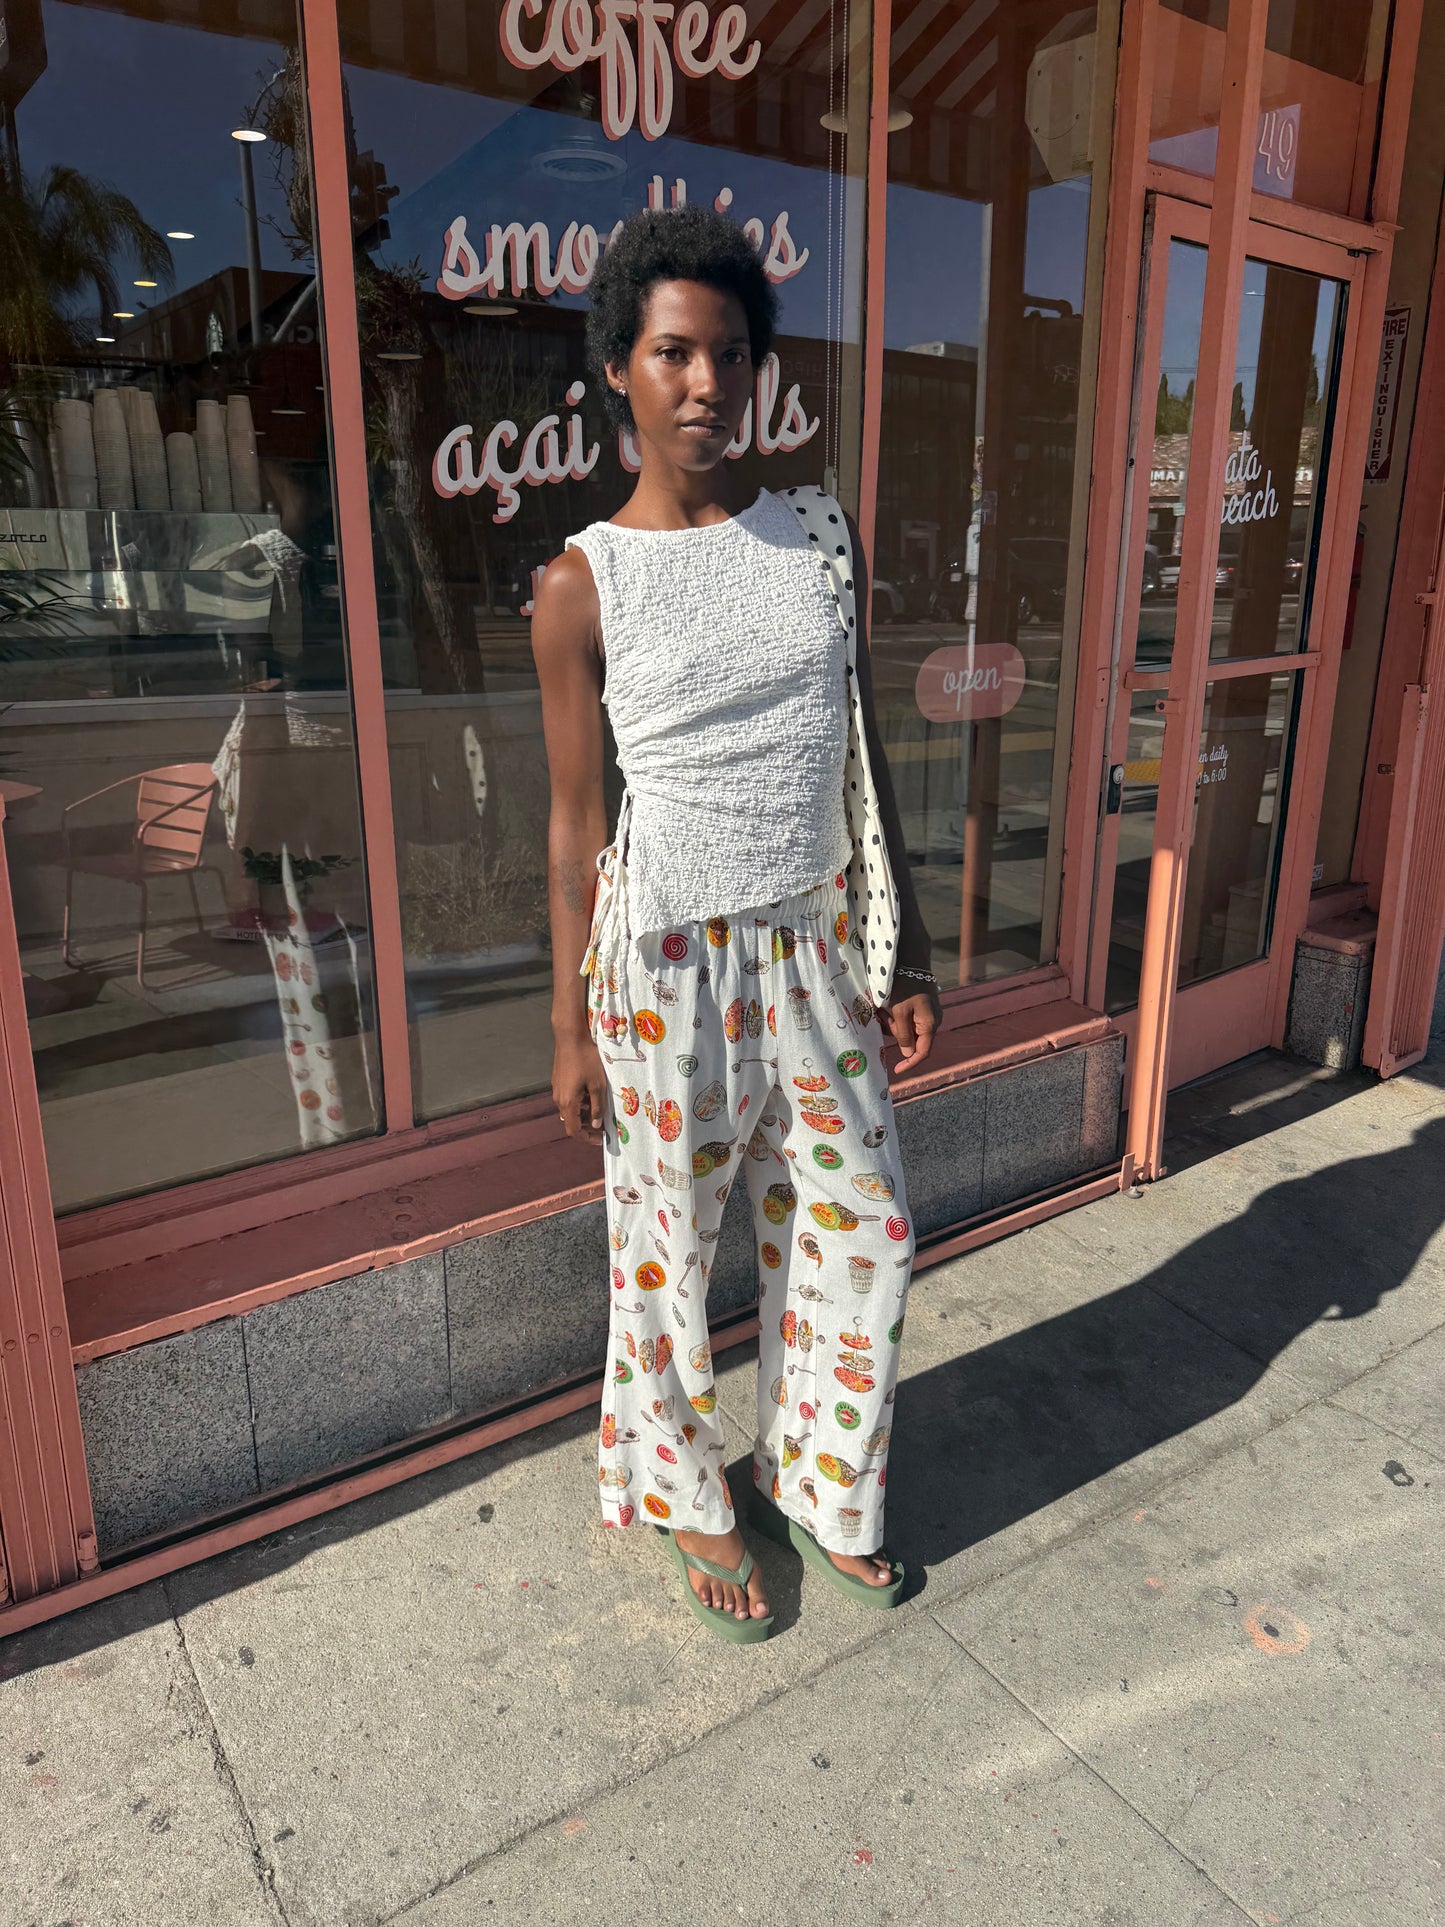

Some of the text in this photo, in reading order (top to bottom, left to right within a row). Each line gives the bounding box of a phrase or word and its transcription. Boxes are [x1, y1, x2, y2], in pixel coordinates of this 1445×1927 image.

[501, 0, 762, 140] coffee
[1258, 111, 1296, 181] 49
[1383, 318, 1407, 336] IRE
[1370, 339, 1395, 471] EXTINGUISHER
[432, 380, 600, 524] açai
[1224, 430, 1262, 484] ata
[942, 666, 1002, 713] open
[1198, 744, 1229, 767] en daily
[1203, 771, 1210, 784] to
[1211, 767, 1227, 783] 6:00
